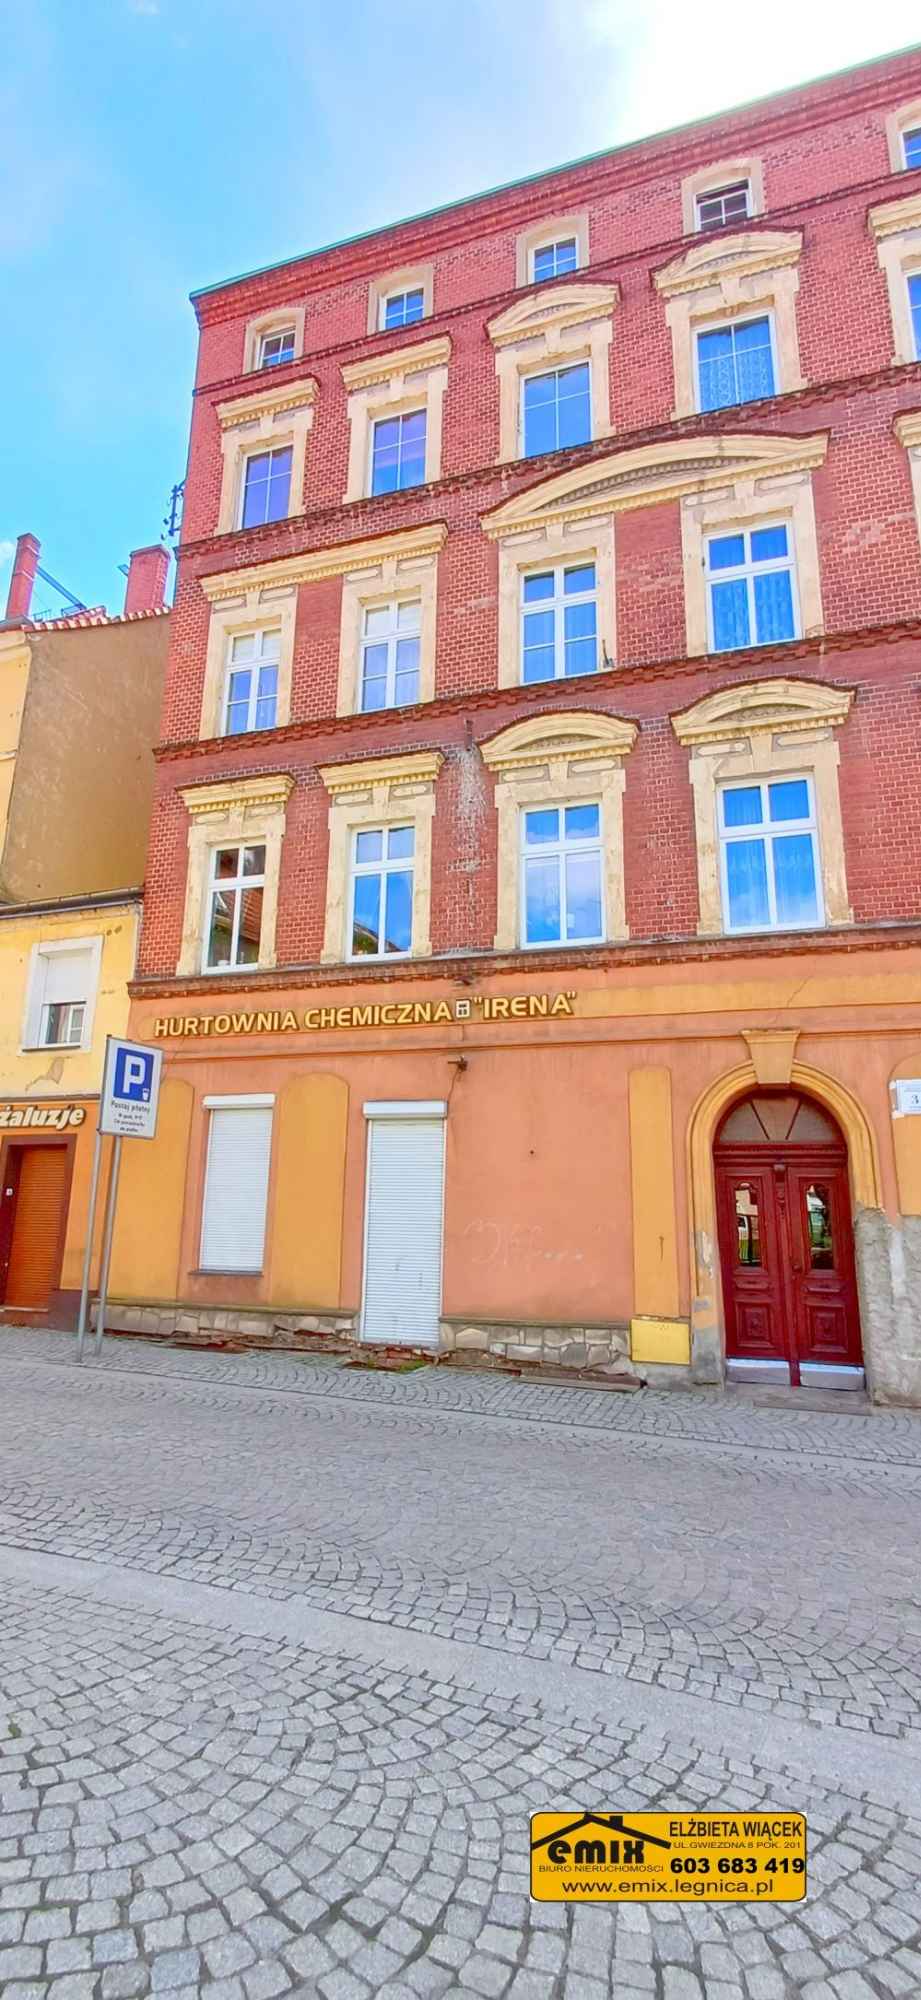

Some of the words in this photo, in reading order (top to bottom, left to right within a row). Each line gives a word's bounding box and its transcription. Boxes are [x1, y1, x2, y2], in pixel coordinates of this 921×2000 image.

[154, 1010, 299, 1038] HURTOWNIA
[304, 1000, 454, 1030] CHEMICZNA
[474, 991, 577, 1020] "IRENA"
[122, 1054, 146, 1093] P
